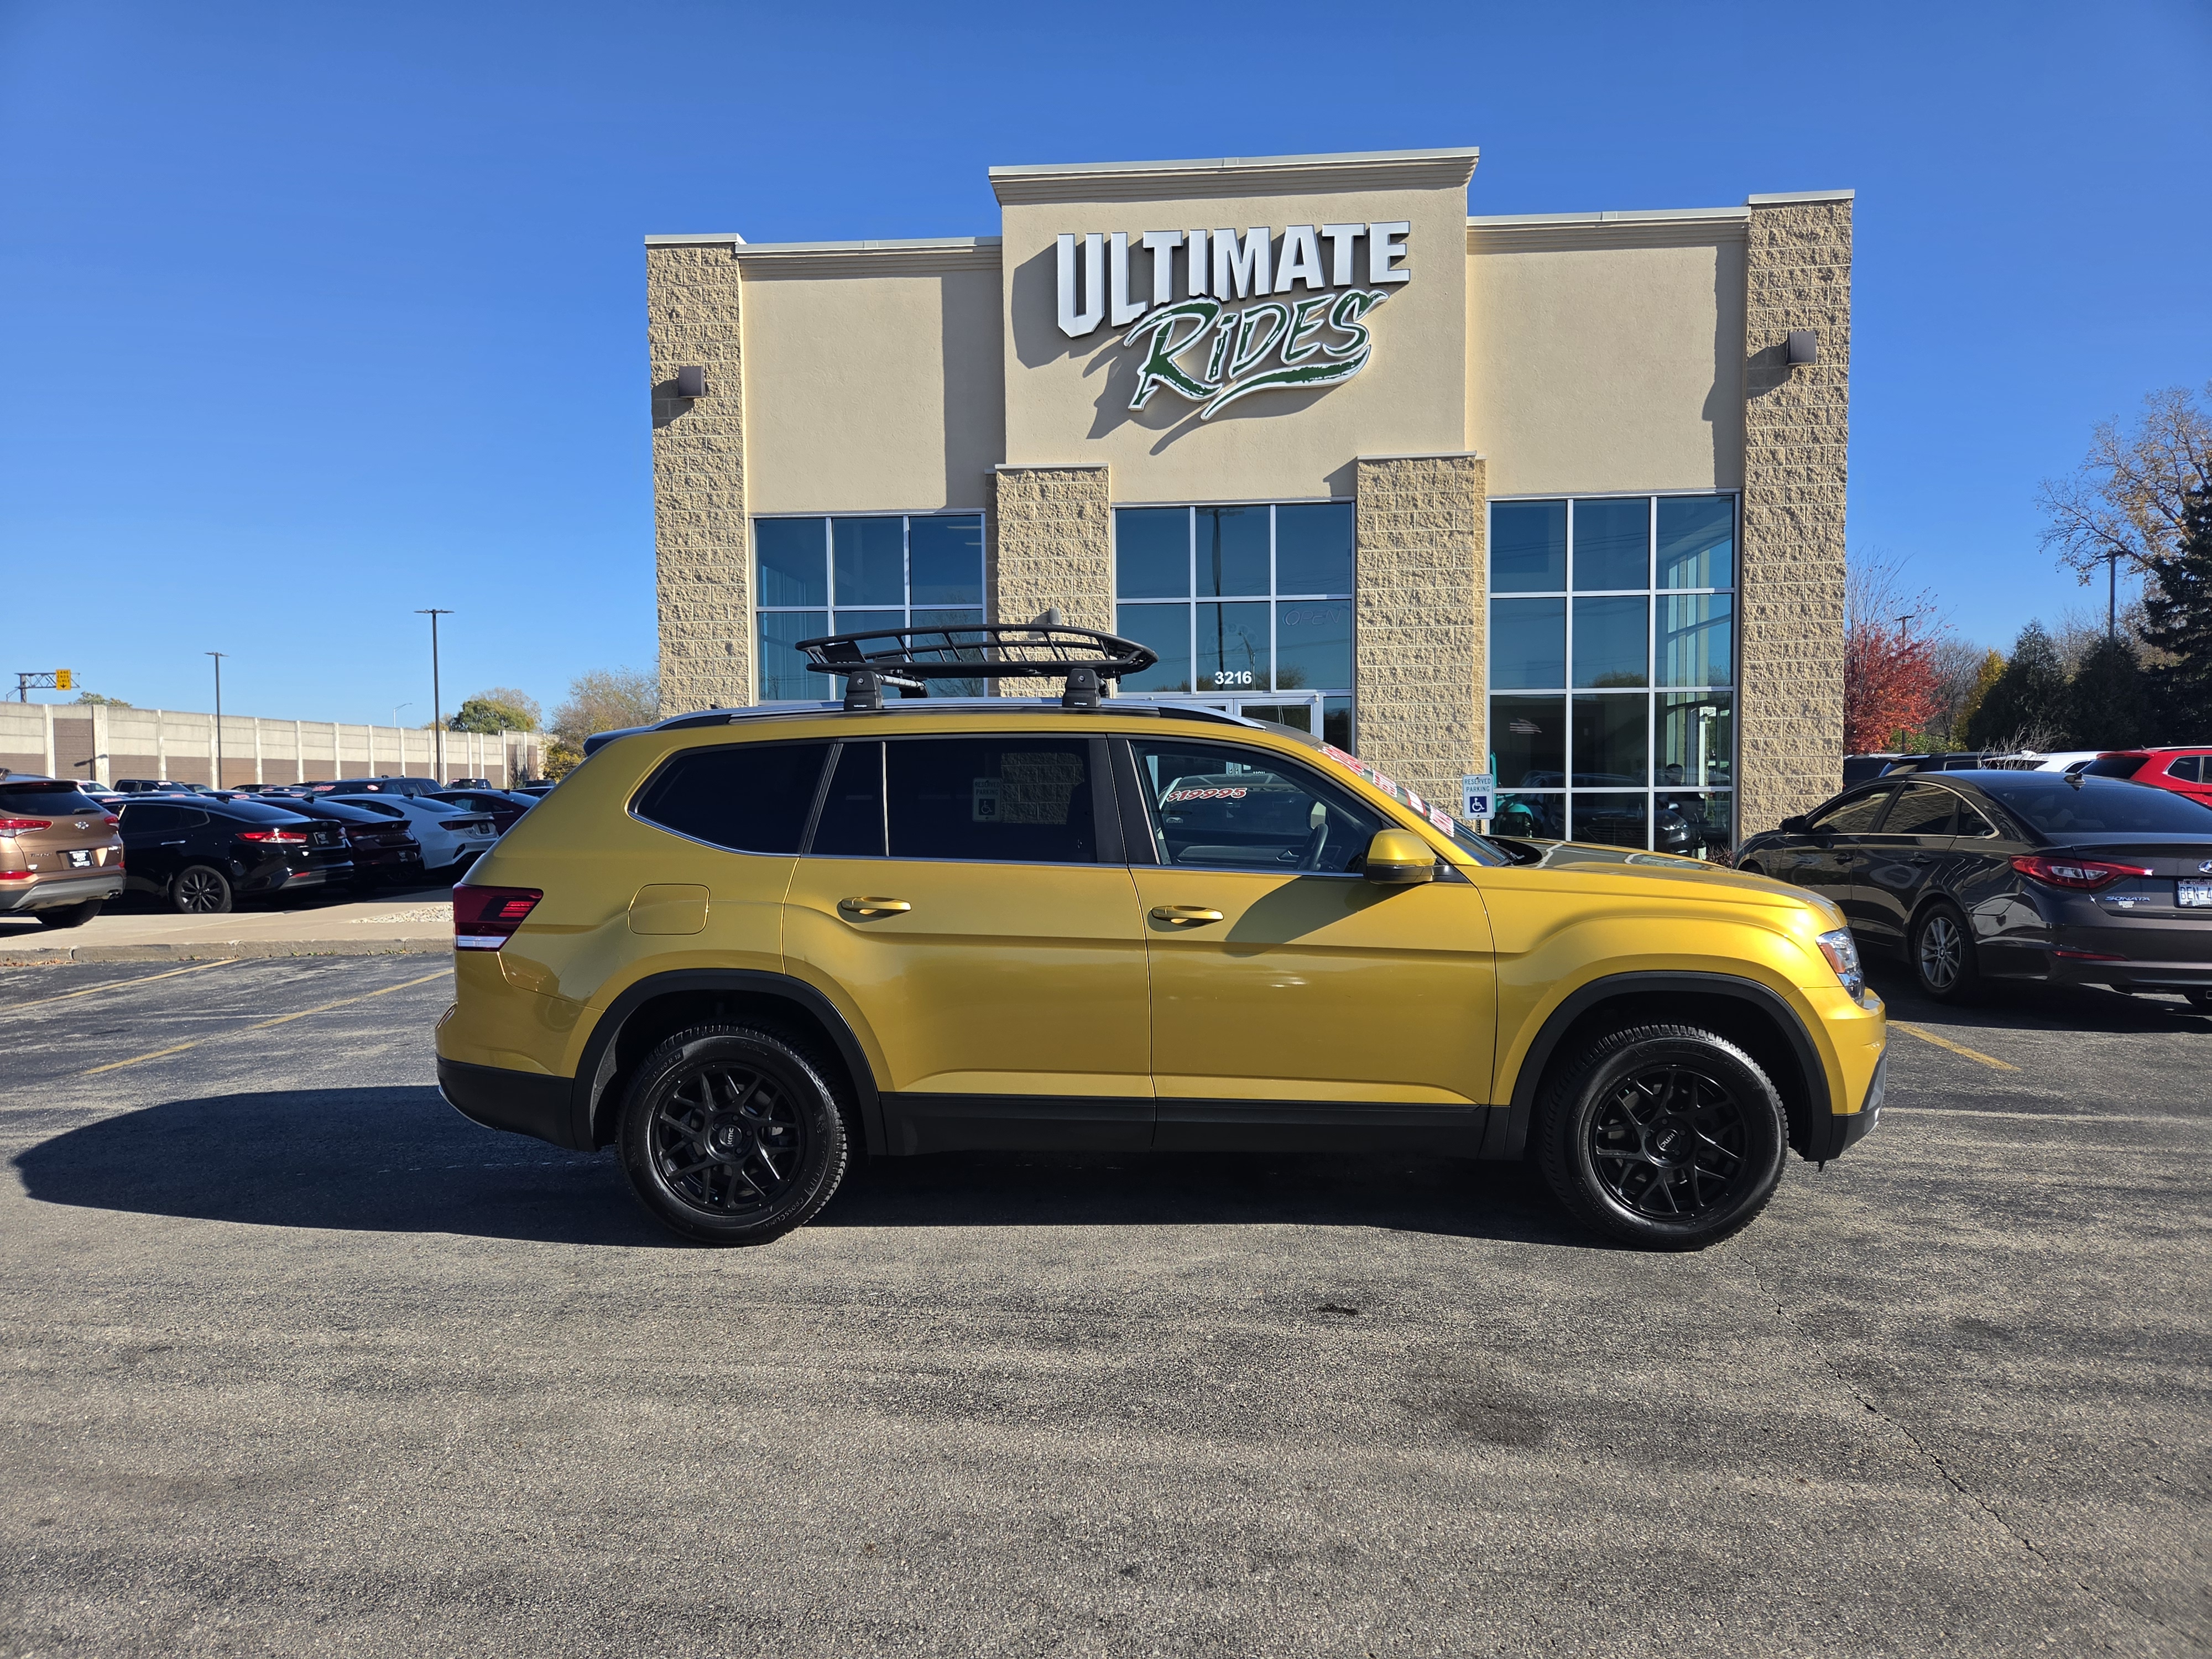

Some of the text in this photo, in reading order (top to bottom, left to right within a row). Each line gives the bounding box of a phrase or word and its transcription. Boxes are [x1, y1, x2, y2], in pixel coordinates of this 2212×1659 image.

[1057, 221, 1411, 338] ULTIMATE
[1285, 609, 1341, 626] OPEN
[1214, 671, 1253, 685] 3216
[1166, 787, 1248, 802] $19995
